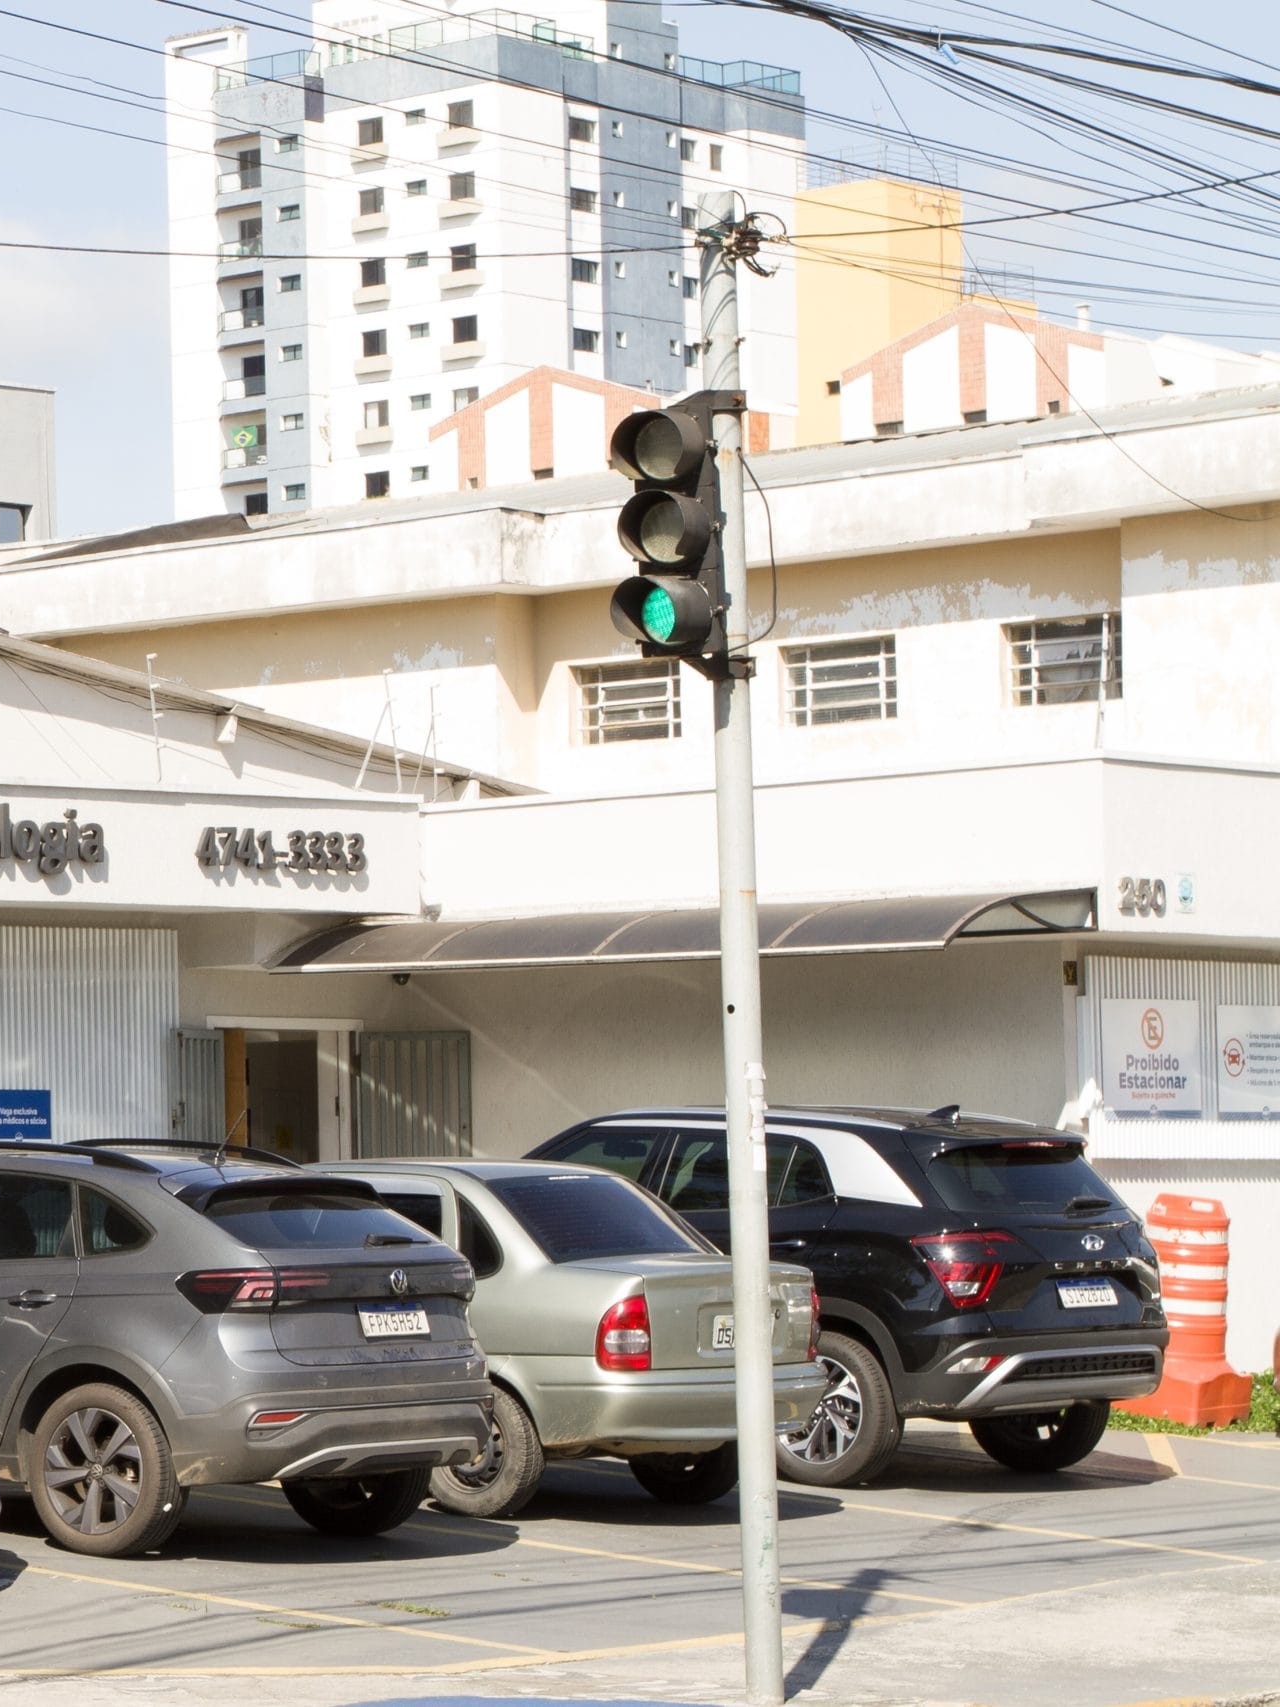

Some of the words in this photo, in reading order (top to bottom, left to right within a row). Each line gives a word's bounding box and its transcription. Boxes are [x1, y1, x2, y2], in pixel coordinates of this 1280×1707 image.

[195, 827, 368, 873] 4741-3333
[1118, 876, 1167, 918] 250
[1126, 1053, 1179, 1071] Proibido
[1119, 1072, 1187, 1089] Estacionar
[0, 1107, 12, 1117] Vaga
[13, 1107, 38, 1115] exclusiva
[1054, 1259, 1133, 1270] CRETA
[368, 1313, 423, 1332] FPK5H52
